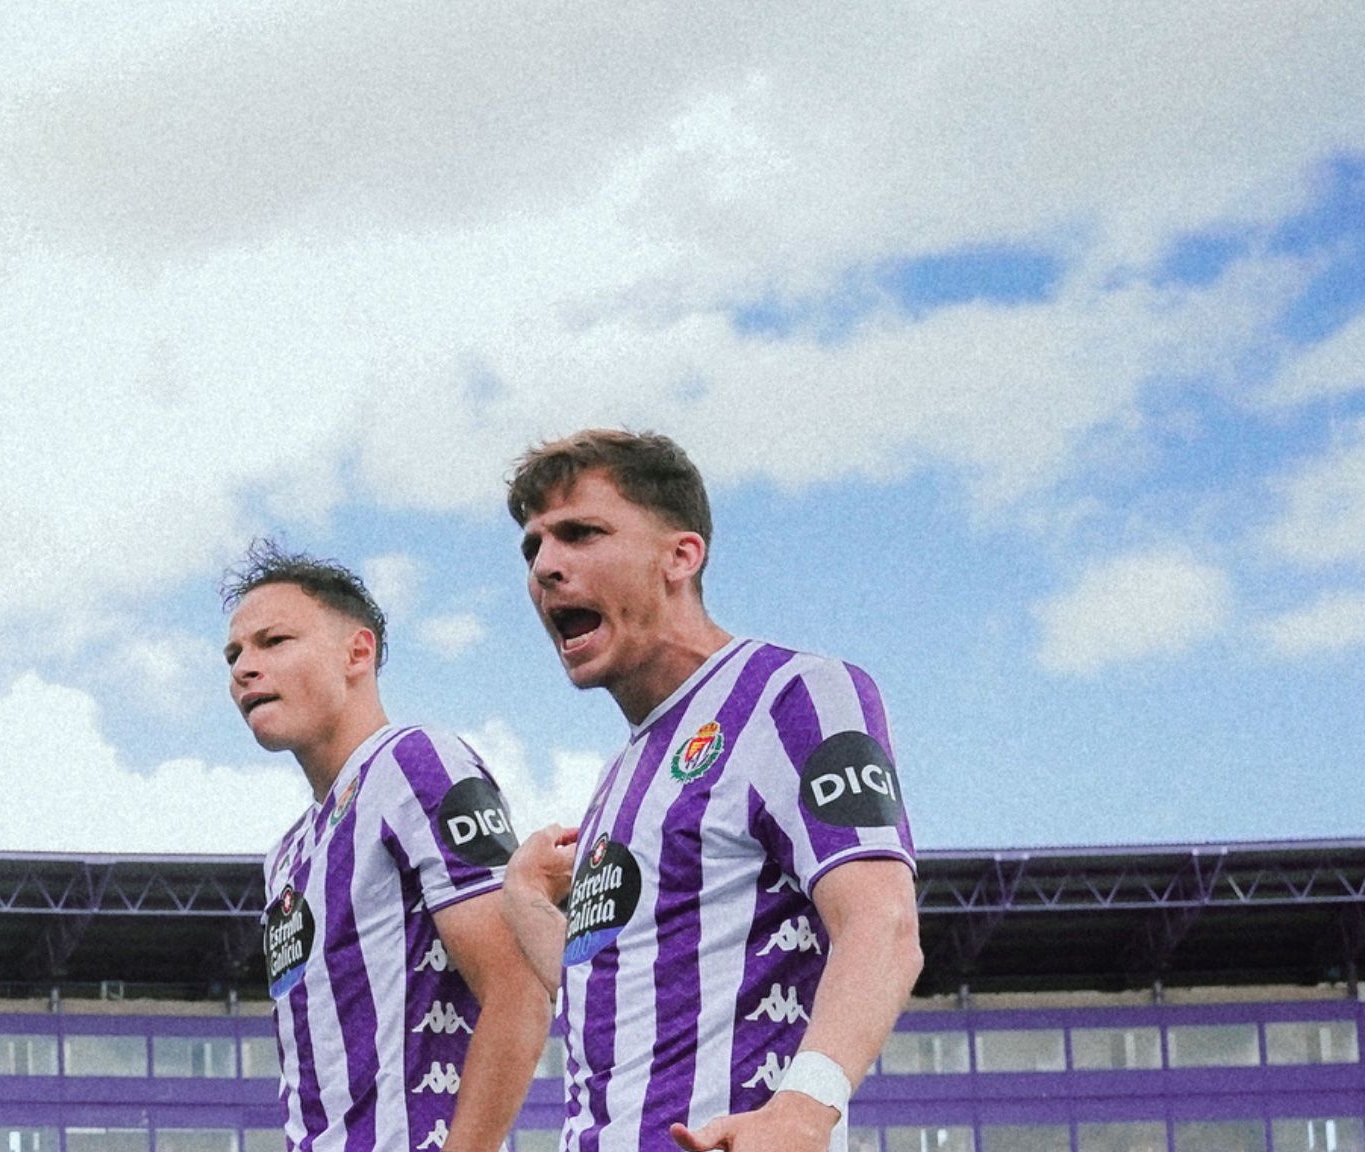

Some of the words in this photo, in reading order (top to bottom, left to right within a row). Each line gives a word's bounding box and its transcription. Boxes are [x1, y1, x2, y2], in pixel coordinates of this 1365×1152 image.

[810, 764, 897, 807] DIGI
[446, 808, 511, 845] DIGI
[570, 863, 623, 909] Estrella
